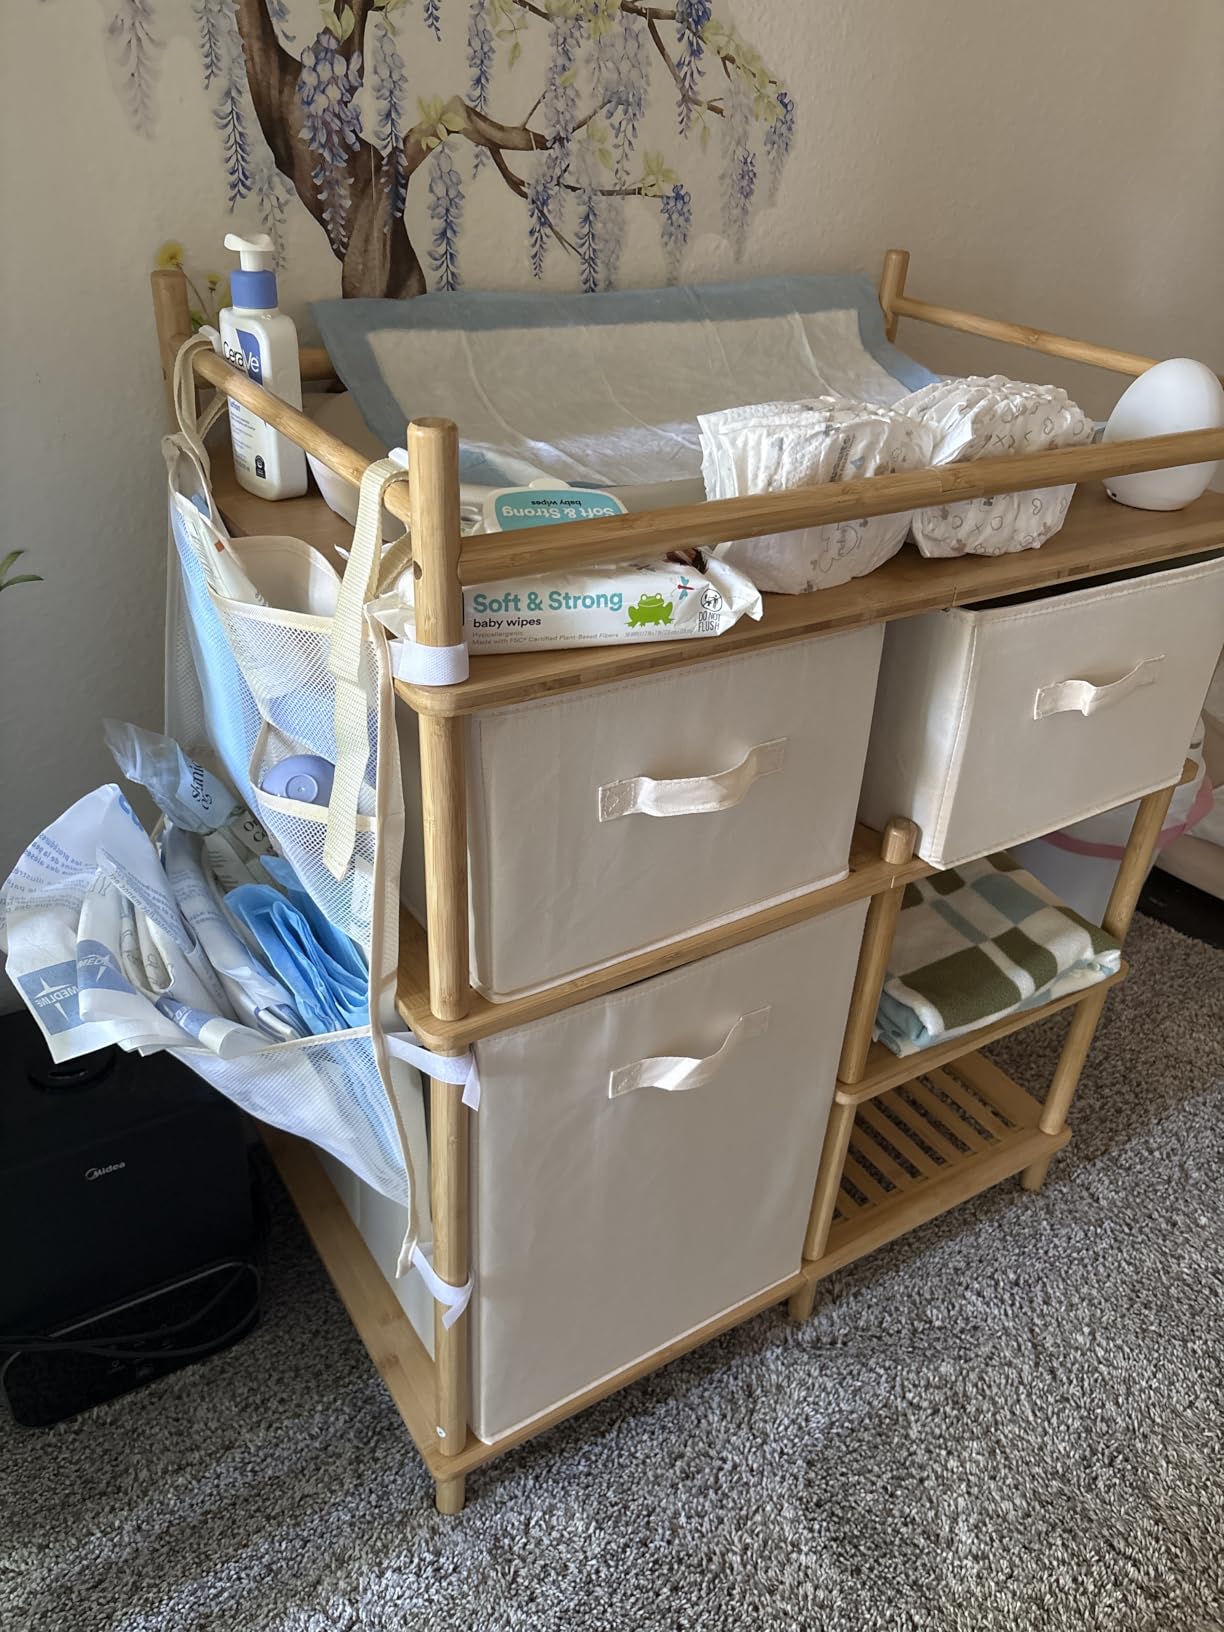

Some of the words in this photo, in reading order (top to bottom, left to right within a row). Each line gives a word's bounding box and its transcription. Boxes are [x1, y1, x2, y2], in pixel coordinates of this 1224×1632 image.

[223, 341, 260, 373] CeraVe
[530, 499, 558, 507] wipes
[559, 499, 581, 507] baby
[502, 506, 560, 519] Strong
[564, 508, 577, 519] &
[579, 507, 614, 518] Soft
[473, 592, 521, 613] Soft
[527, 591, 543, 611] &
[548, 590, 623, 612] Strong
[698, 610, 708, 622] DO
[473, 618, 503, 629] baby
[506, 617, 541, 628] wipes
[698, 620, 720, 632] FLUSH
[86, 1162, 126, 1180] Midea
